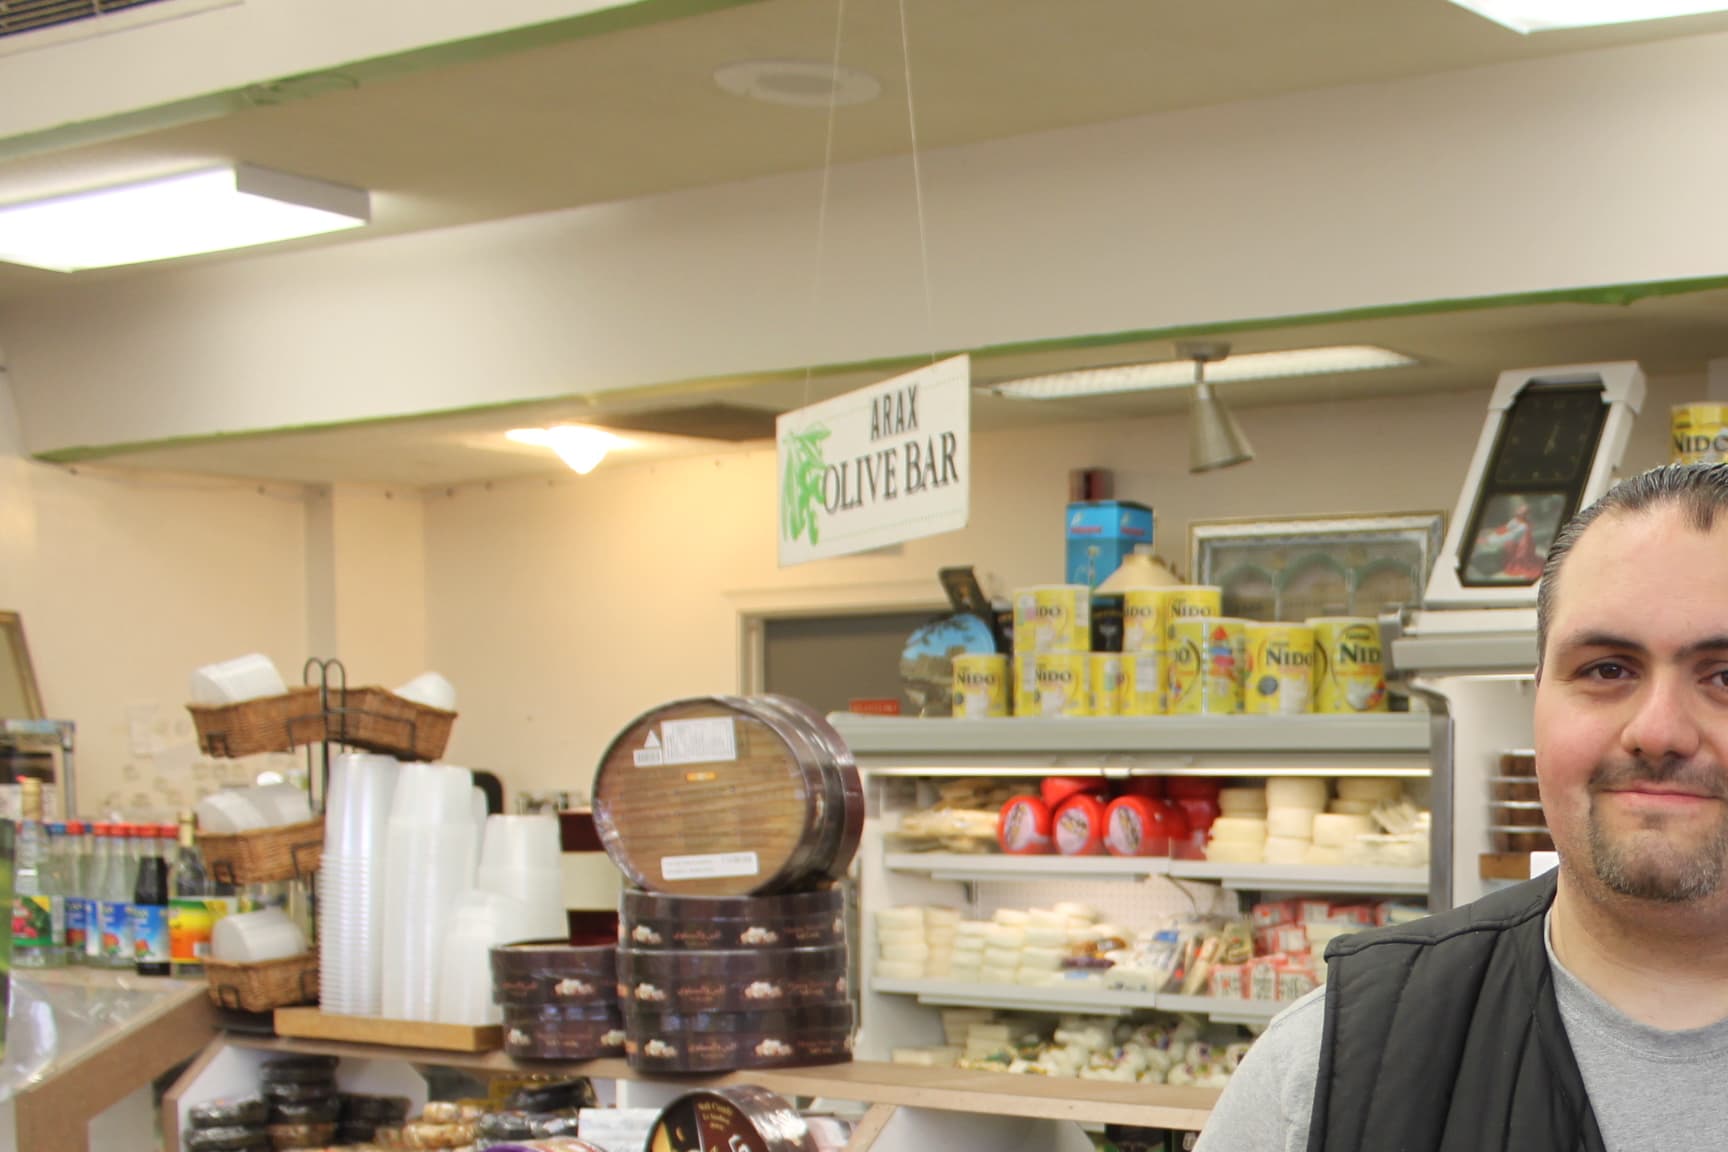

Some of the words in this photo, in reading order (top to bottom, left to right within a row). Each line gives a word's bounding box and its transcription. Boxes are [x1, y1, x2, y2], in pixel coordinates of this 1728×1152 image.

[871, 384, 918, 442] ARAX
[823, 448, 898, 514] OLIVE
[904, 431, 959, 495] BAR
[1339, 645, 1381, 663] NID
